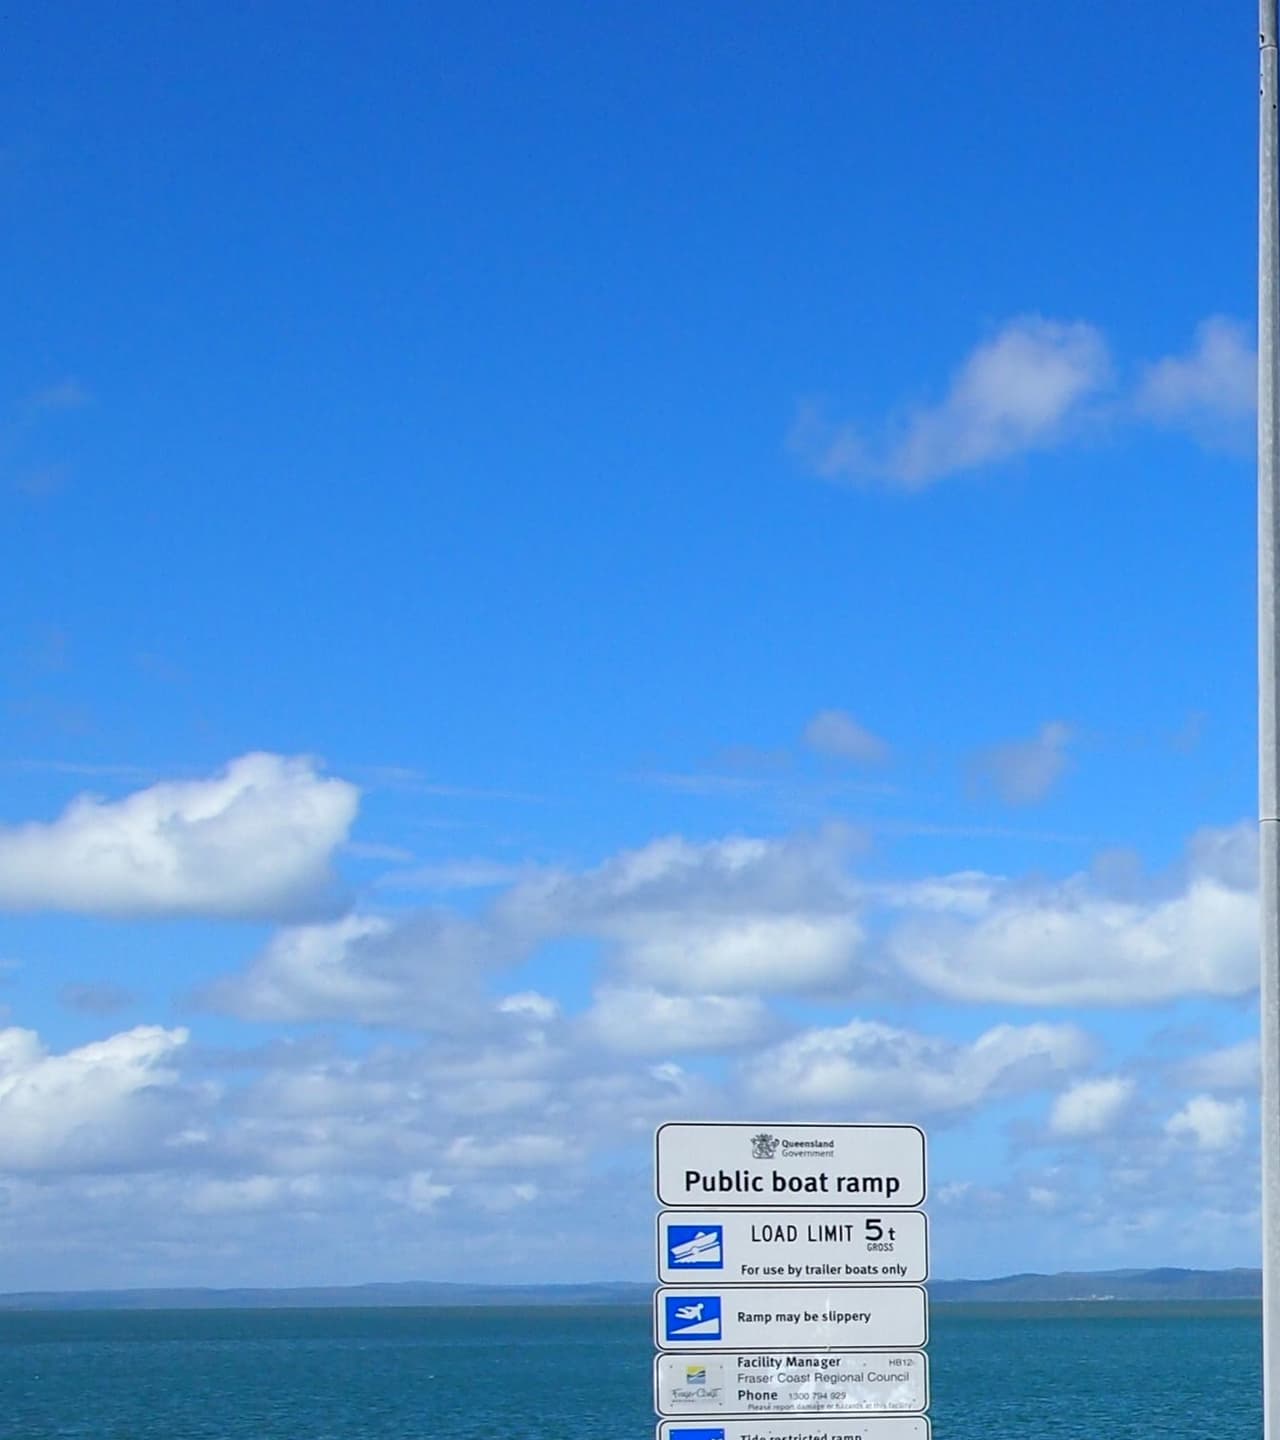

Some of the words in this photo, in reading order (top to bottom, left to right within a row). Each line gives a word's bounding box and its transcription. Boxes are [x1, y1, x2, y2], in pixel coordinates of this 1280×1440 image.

[781, 1139, 834, 1149] Queensland
[781, 1148, 834, 1158] Government
[685, 1170, 764, 1192] Public
[772, 1171, 828, 1193] boat
[836, 1176, 900, 1198] ramp
[751, 1224, 797, 1242] LOAD
[808, 1224, 853, 1242] LIMIT
[865, 1218, 883, 1241] 5
[888, 1227, 896, 1241] t
[866, 1243, 894, 1252] GROSS
[741, 1264, 760, 1275] For
[763, 1266, 785, 1276] use
[787, 1264, 801, 1277] by
[805, 1264, 842, 1275] trailer
[845, 1264, 879, 1275] boats
[882, 1264, 907, 1277] only
[737, 1312, 772, 1325] Ramp
[775, 1313, 800, 1325] may
[804, 1311, 819, 1322] be
[822, 1311, 871, 1324] slippery
[737, 1356, 782, 1369] Facility
[786, 1356, 841, 1369] Manager
[737, 1373, 773, 1383] Fraser
[777, 1372, 810, 1383] Coast
[814, 1372, 864, 1384] Regional
[867, 1371, 909, 1382] Council
[738, 1389, 778, 1400] Phone
[788, 1392, 809, 1400] 1300
